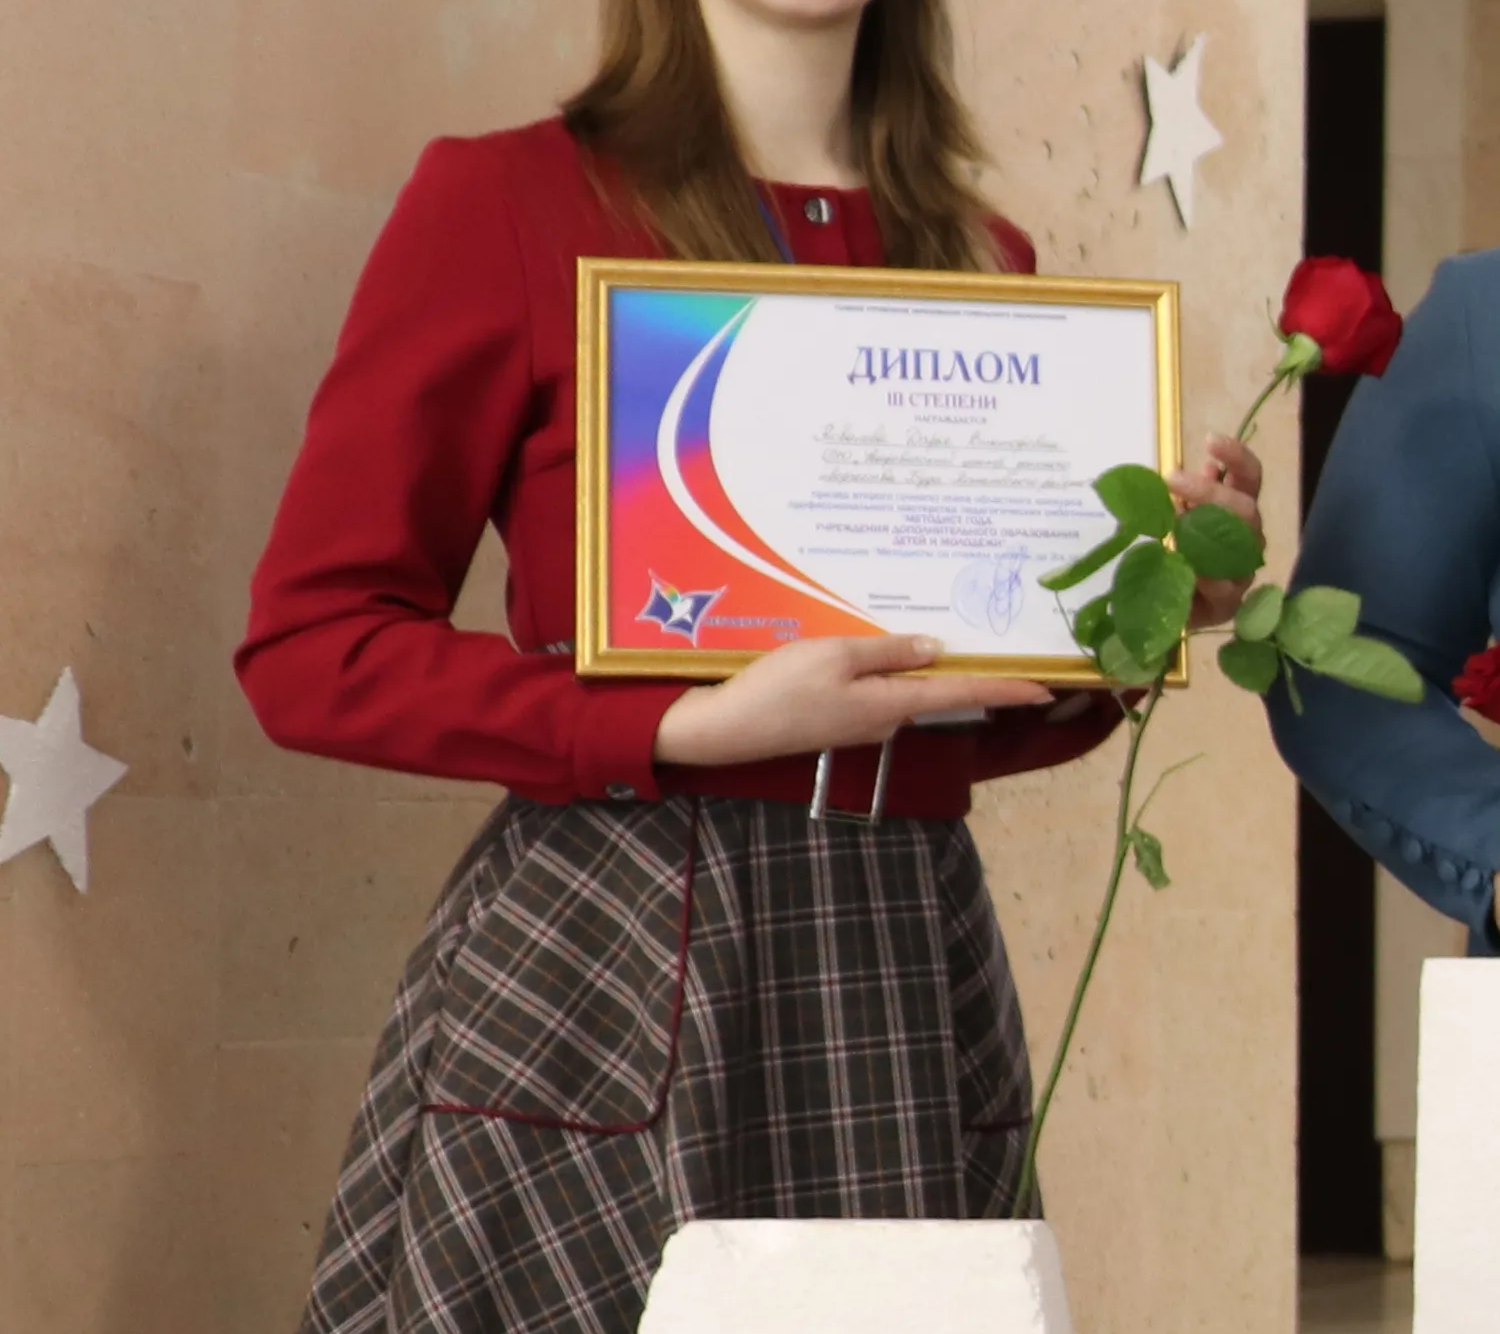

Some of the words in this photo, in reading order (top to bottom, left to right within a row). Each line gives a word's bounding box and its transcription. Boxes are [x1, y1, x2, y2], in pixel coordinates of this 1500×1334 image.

[846, 346, 1040, 391] ДИПЛОМ
[887, 391, 903, 407] III
[908, 392, 997, 410] СТЕПЕНИ
